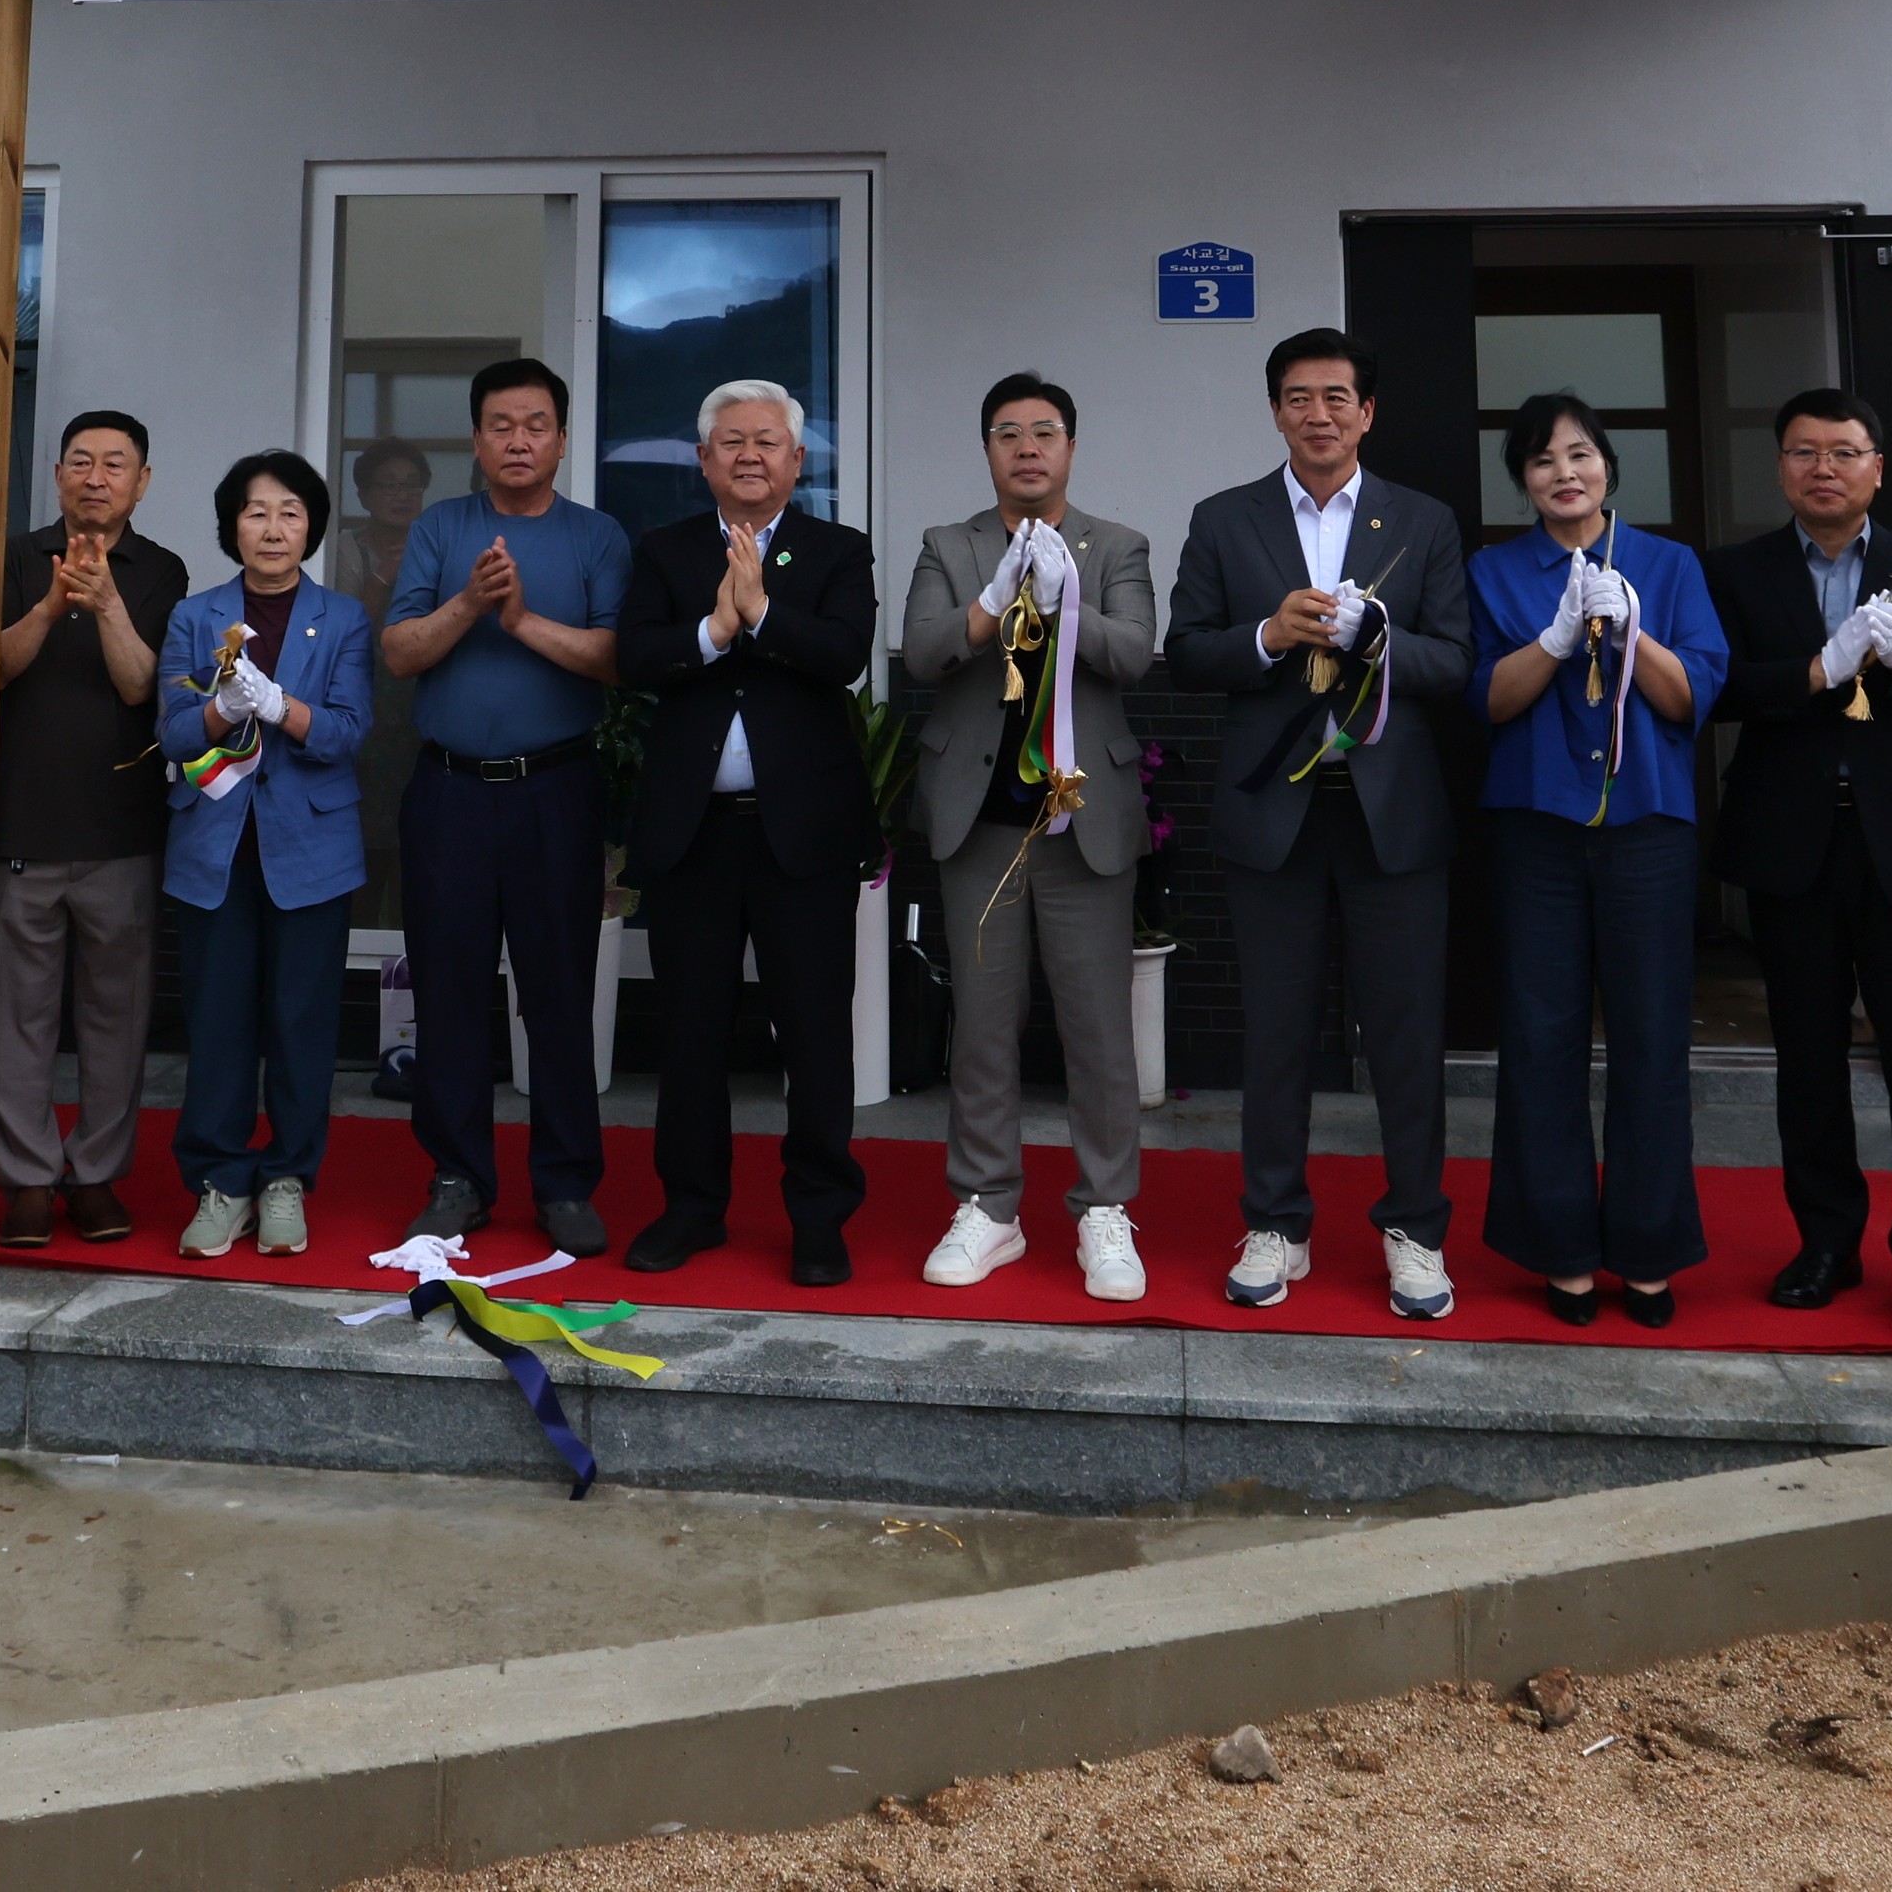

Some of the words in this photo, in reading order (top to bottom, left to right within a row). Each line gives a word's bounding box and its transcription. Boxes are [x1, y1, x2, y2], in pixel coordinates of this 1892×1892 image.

[1182, 248, 1230, 261] 사교길
[1169, 264, 1244, 273] Sagyo-gil
[1194, 279, 1220, 314] 3
